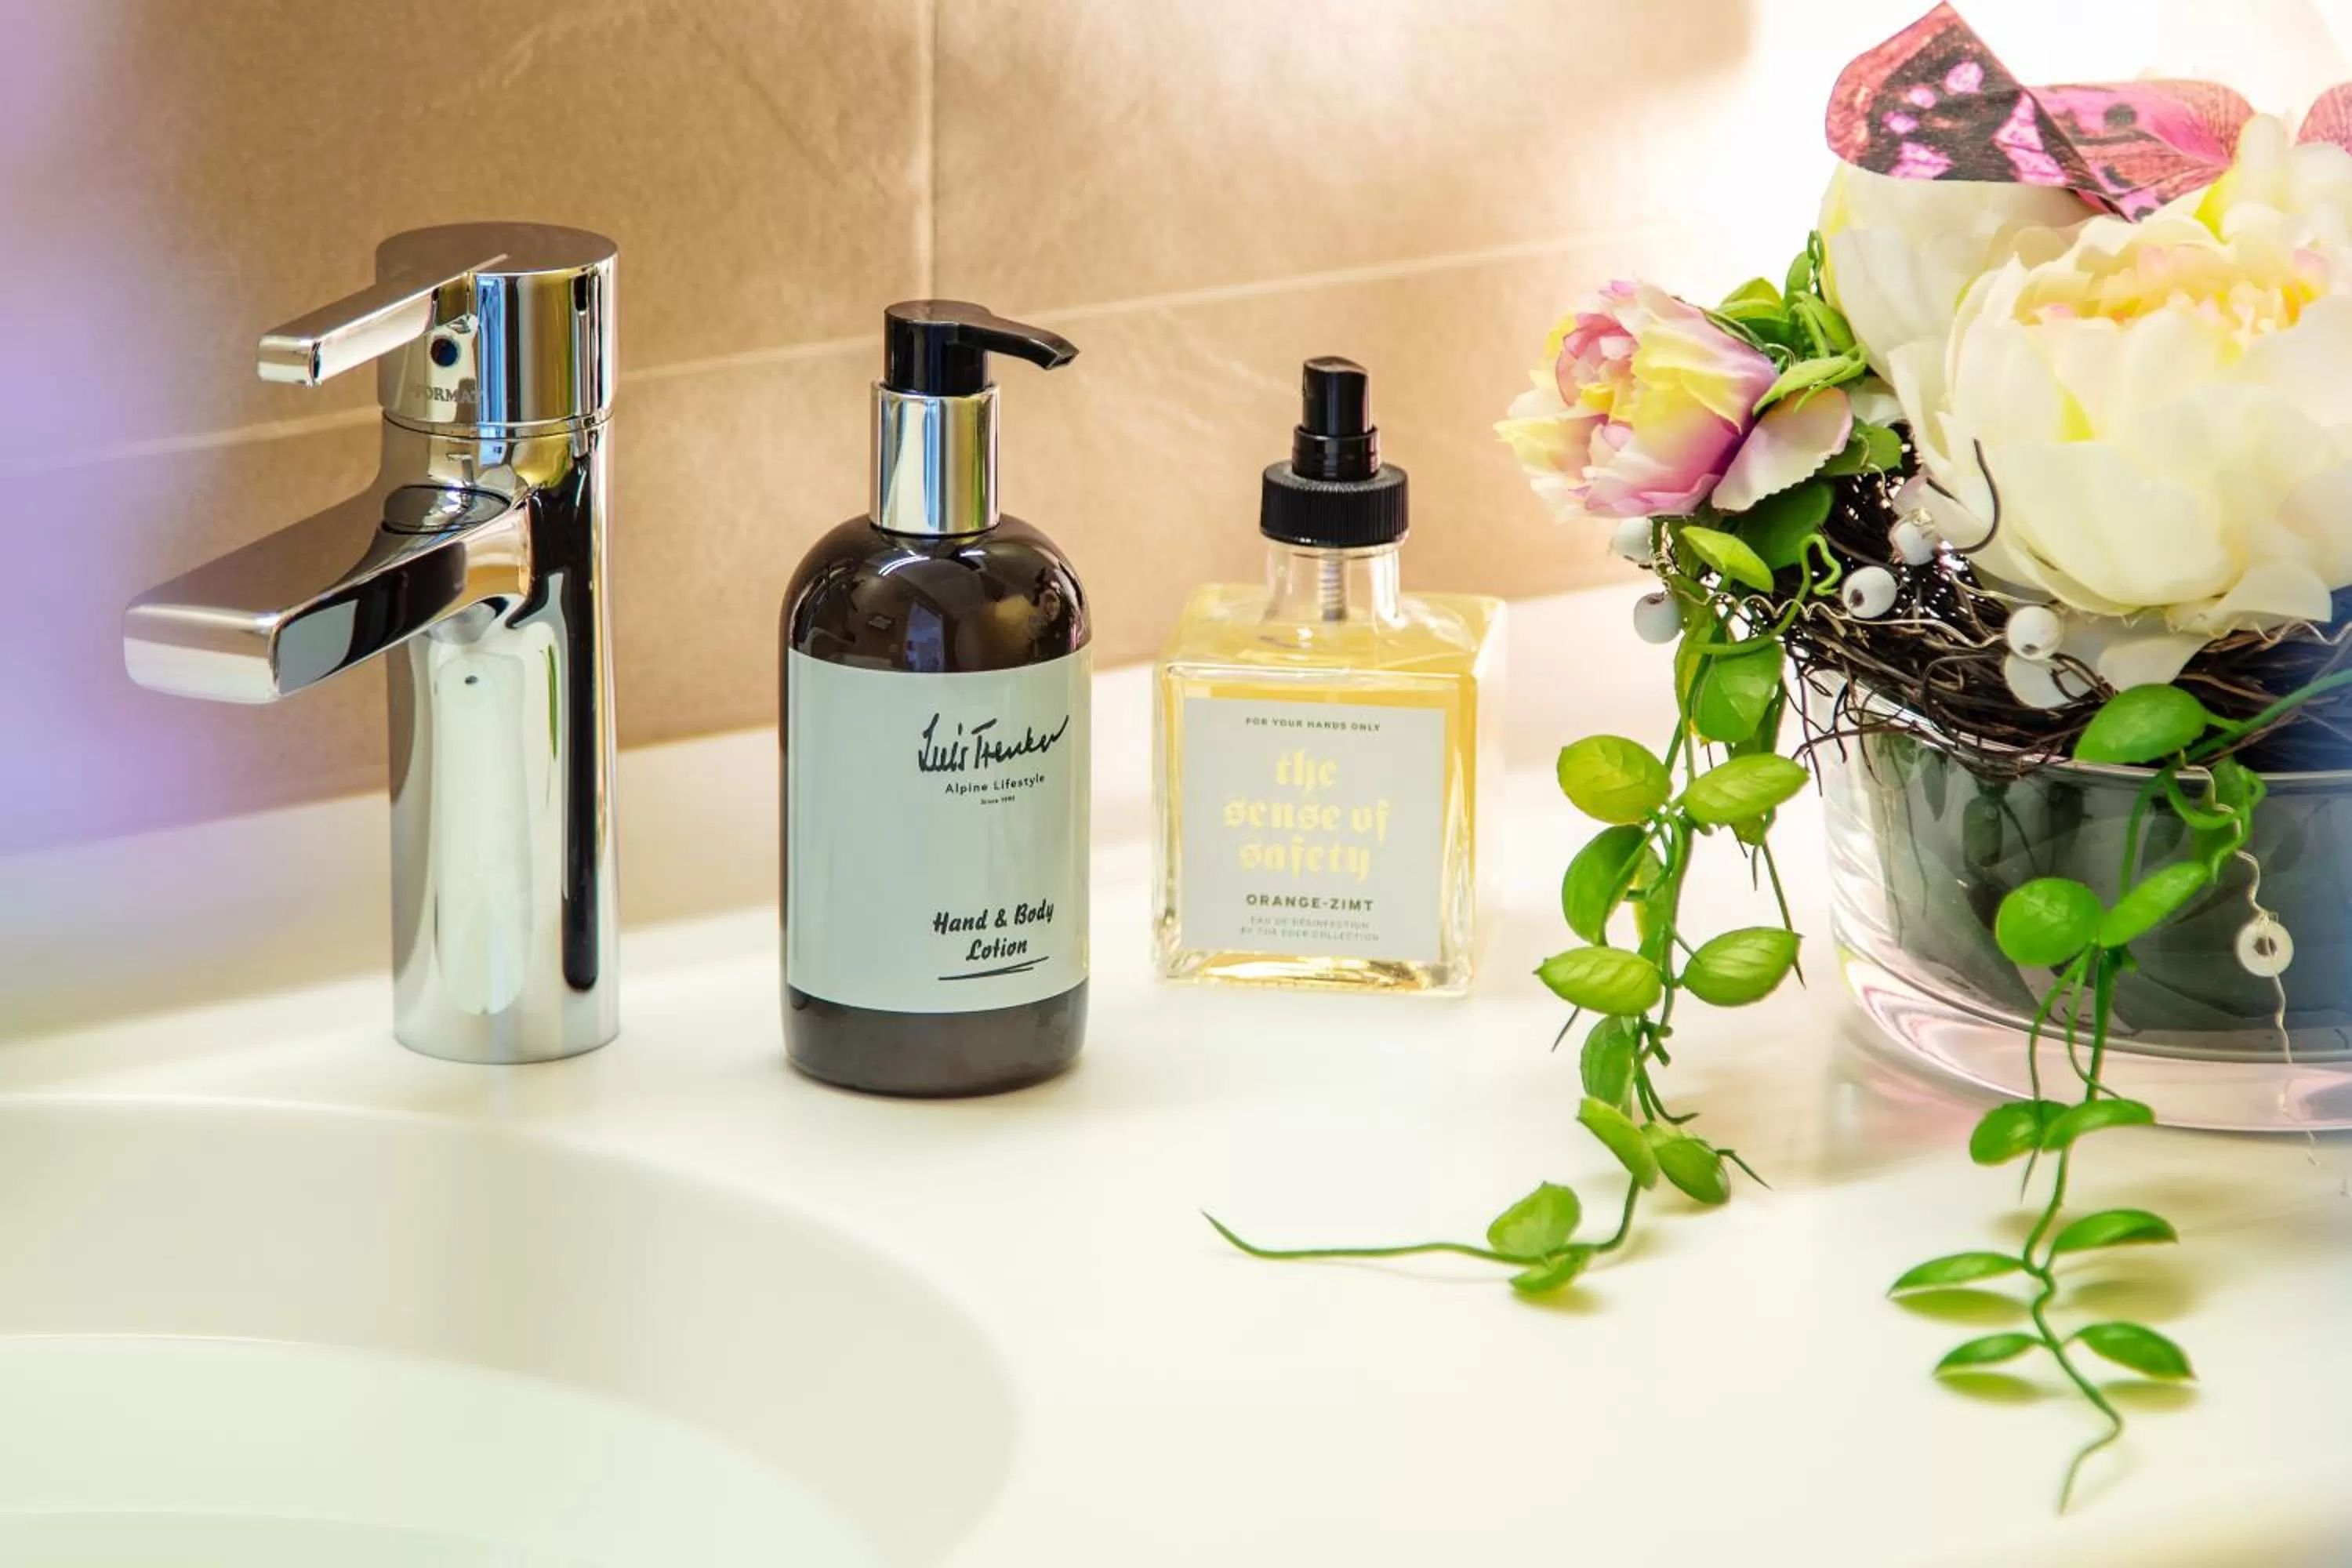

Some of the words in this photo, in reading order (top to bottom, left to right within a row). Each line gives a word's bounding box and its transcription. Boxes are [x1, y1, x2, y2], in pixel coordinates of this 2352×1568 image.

[1272, 718, 1303, 728] YOUR
[1307, 720, 1347, 731] HANDS
[1351, 722, 1381, 731] ONLY
[945, 783, 988, 795] Alpine
[993, 773, 1045, 791] Lifestyle
[1276, 748, 1338, 793] the
[1223, 796, 1341, 831] sense
[1349, 798, 1390, 847] of
[1239, 834, 1370, 884] safety
[933, 909, 988, 935] Hand
[994, 909, 1007, 928] &
[1014, 898, 1054, 924] Body
[1245, 893, 1374, 911] ORANGE-ZIMT
[966, 938, 1028, 961] Lotion
